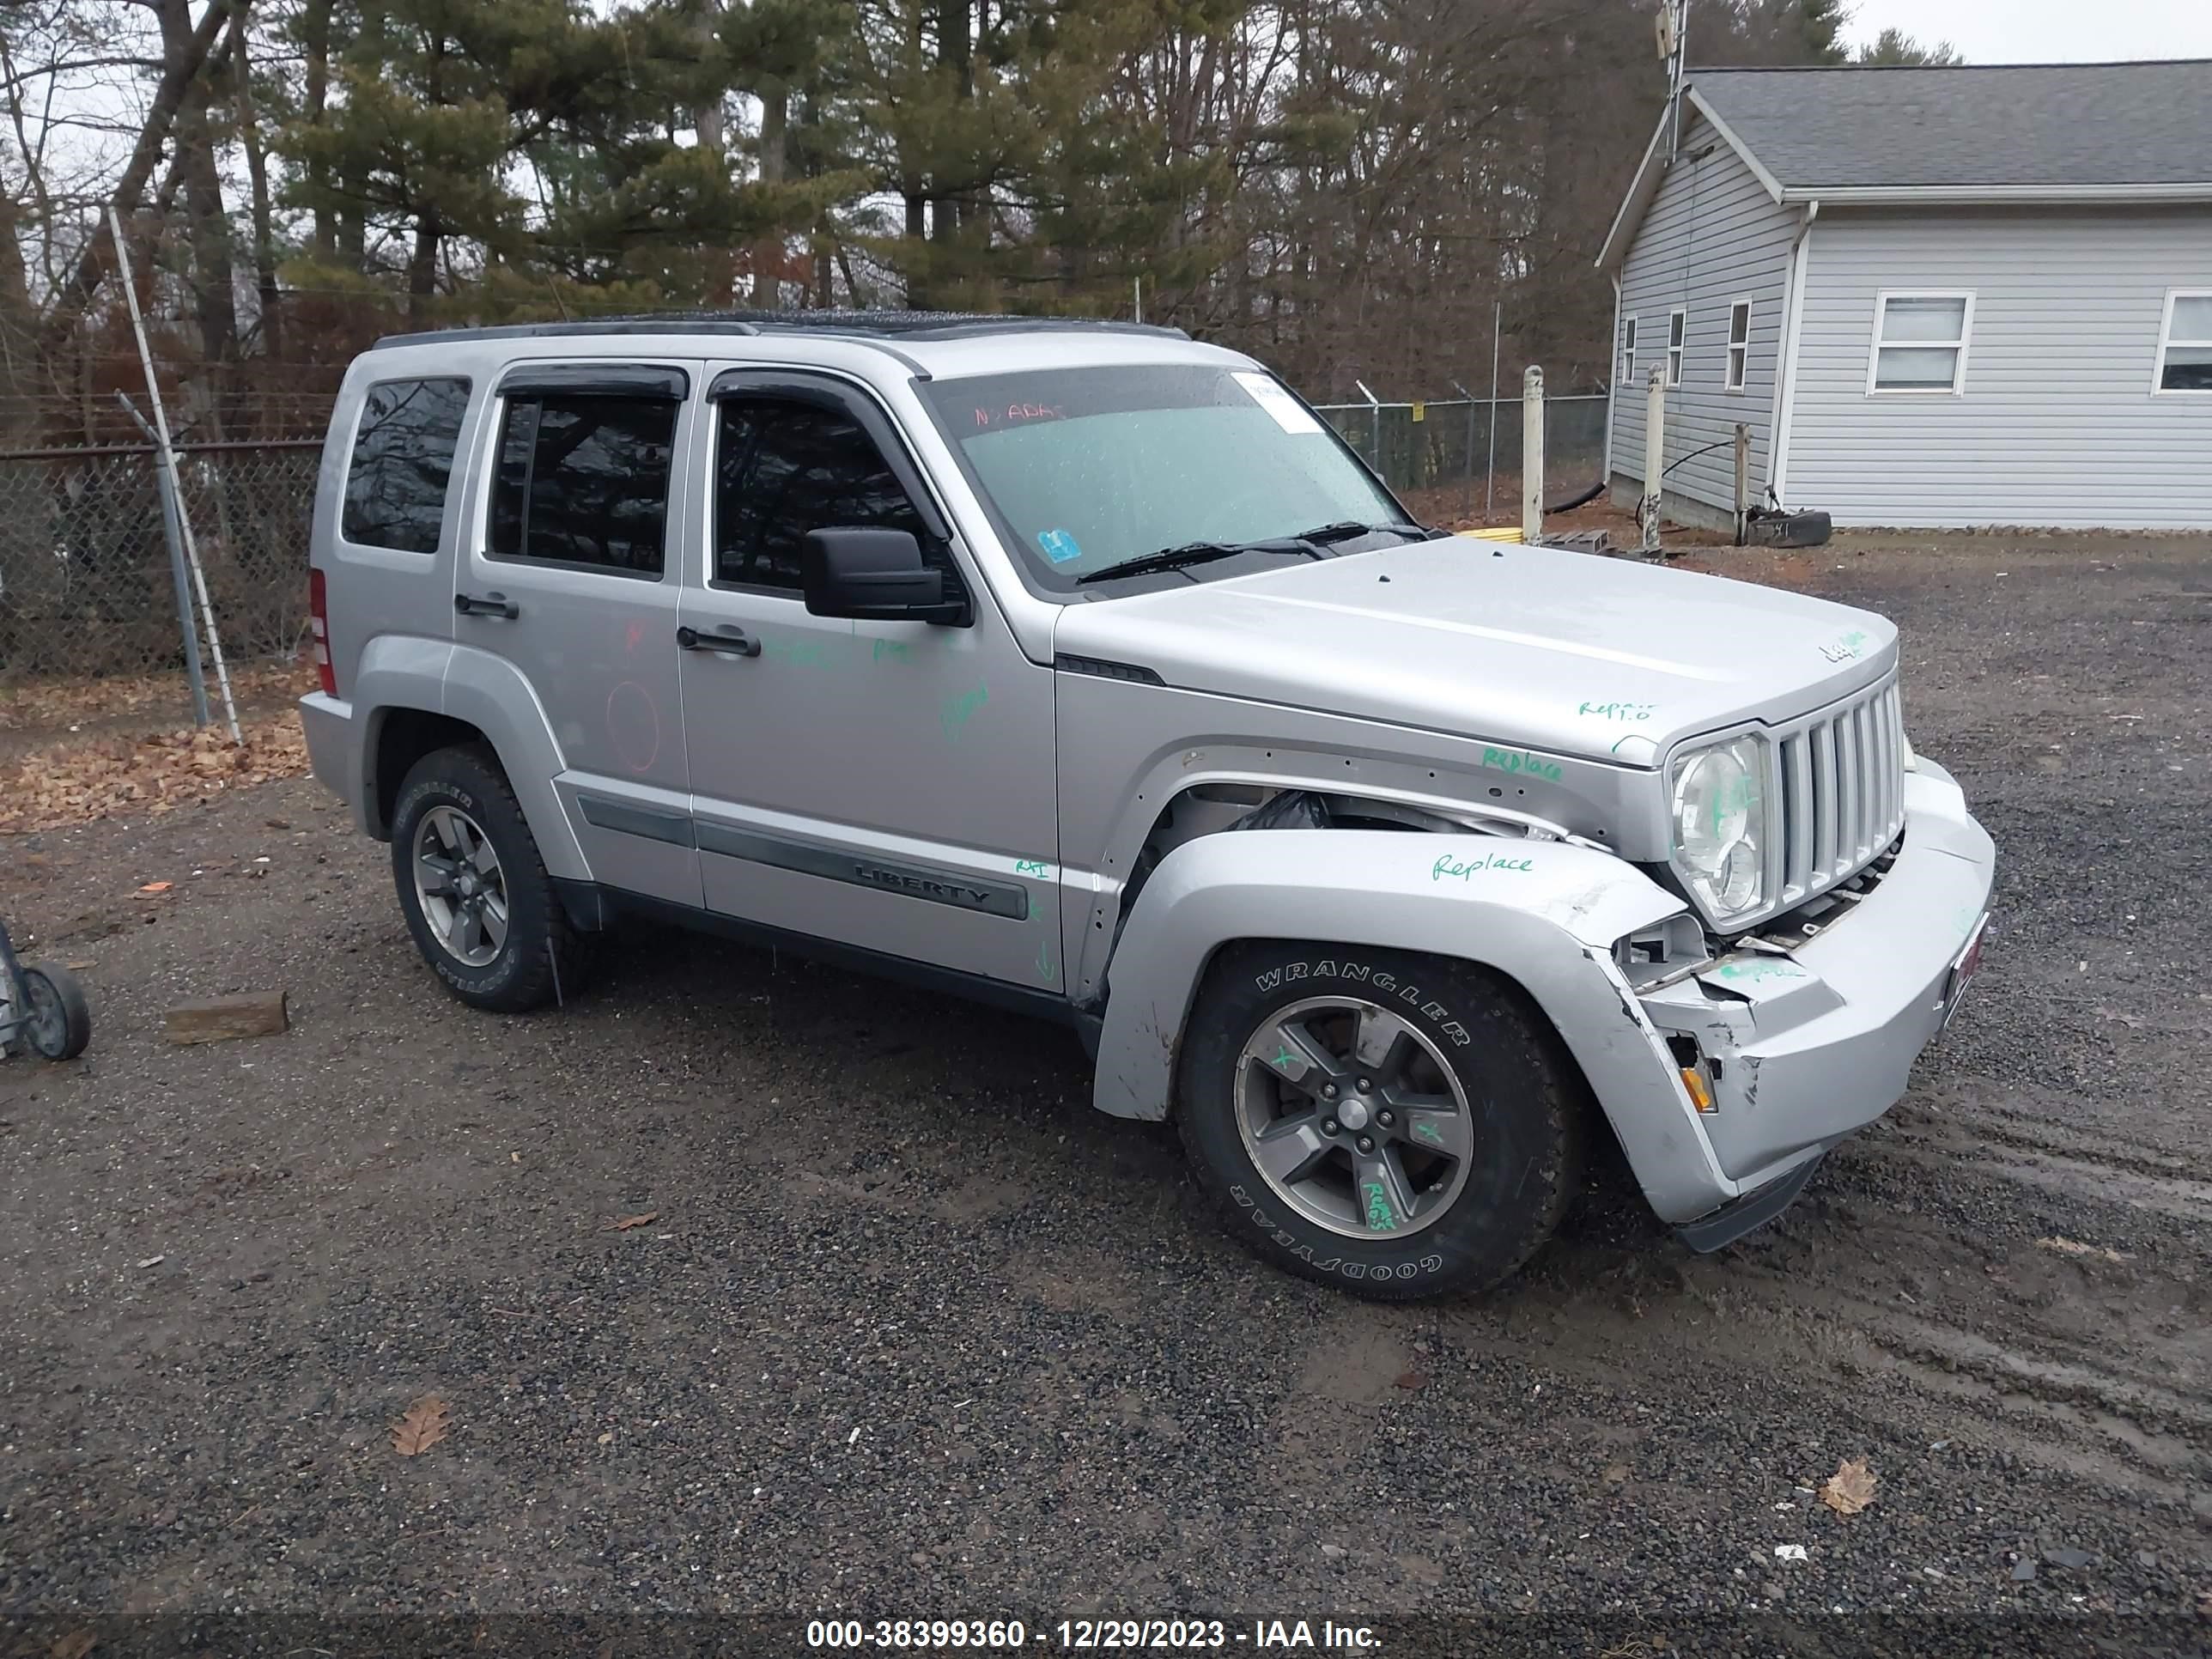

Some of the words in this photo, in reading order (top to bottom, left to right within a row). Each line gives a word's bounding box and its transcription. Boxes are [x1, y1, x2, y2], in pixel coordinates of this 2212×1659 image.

[854, 865, 990, 903] LIBERTY
[1432, 852, 1533, 882] Replace
[1255, 959, 1471, 1047] WRANGLER
[1229, 1184, 1443, 1281] GOODYEAR
